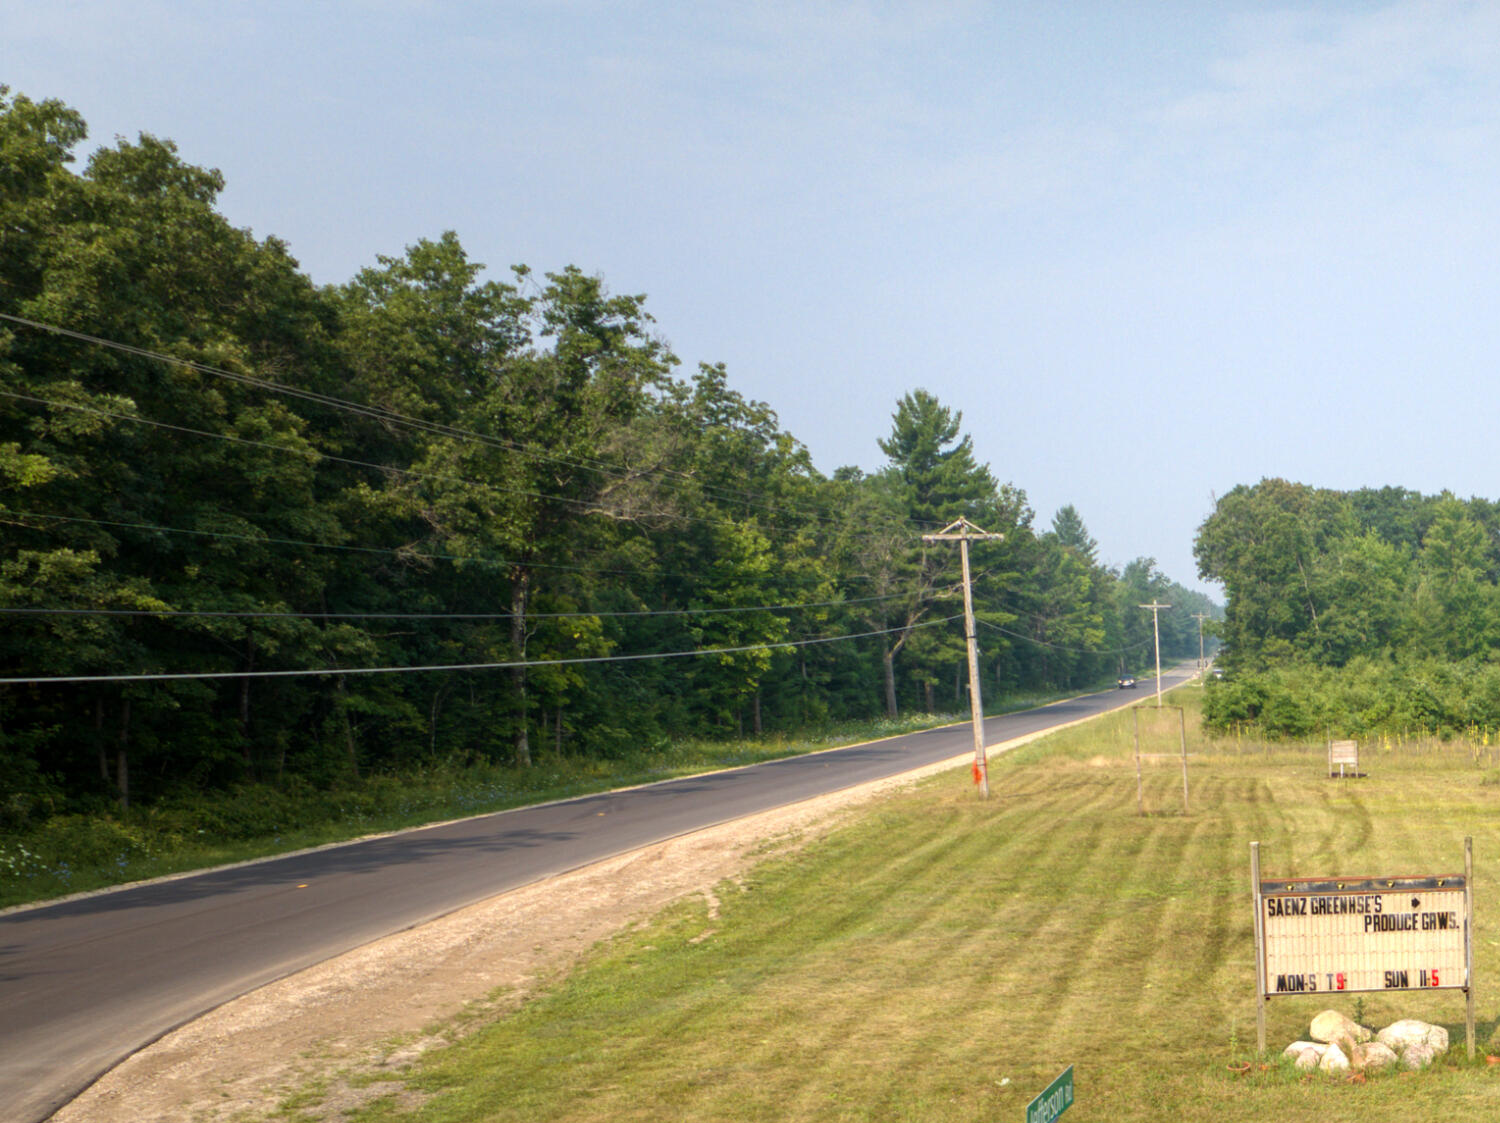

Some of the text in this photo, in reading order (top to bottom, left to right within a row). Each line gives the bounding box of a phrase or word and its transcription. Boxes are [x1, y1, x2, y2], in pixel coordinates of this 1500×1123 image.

[1268, 895, 1382, 917] SAENZ GREENHSE'S
[1364, 913, 1419, 933] PRODUCE
[1384, 970, 1409, 988] SUN
